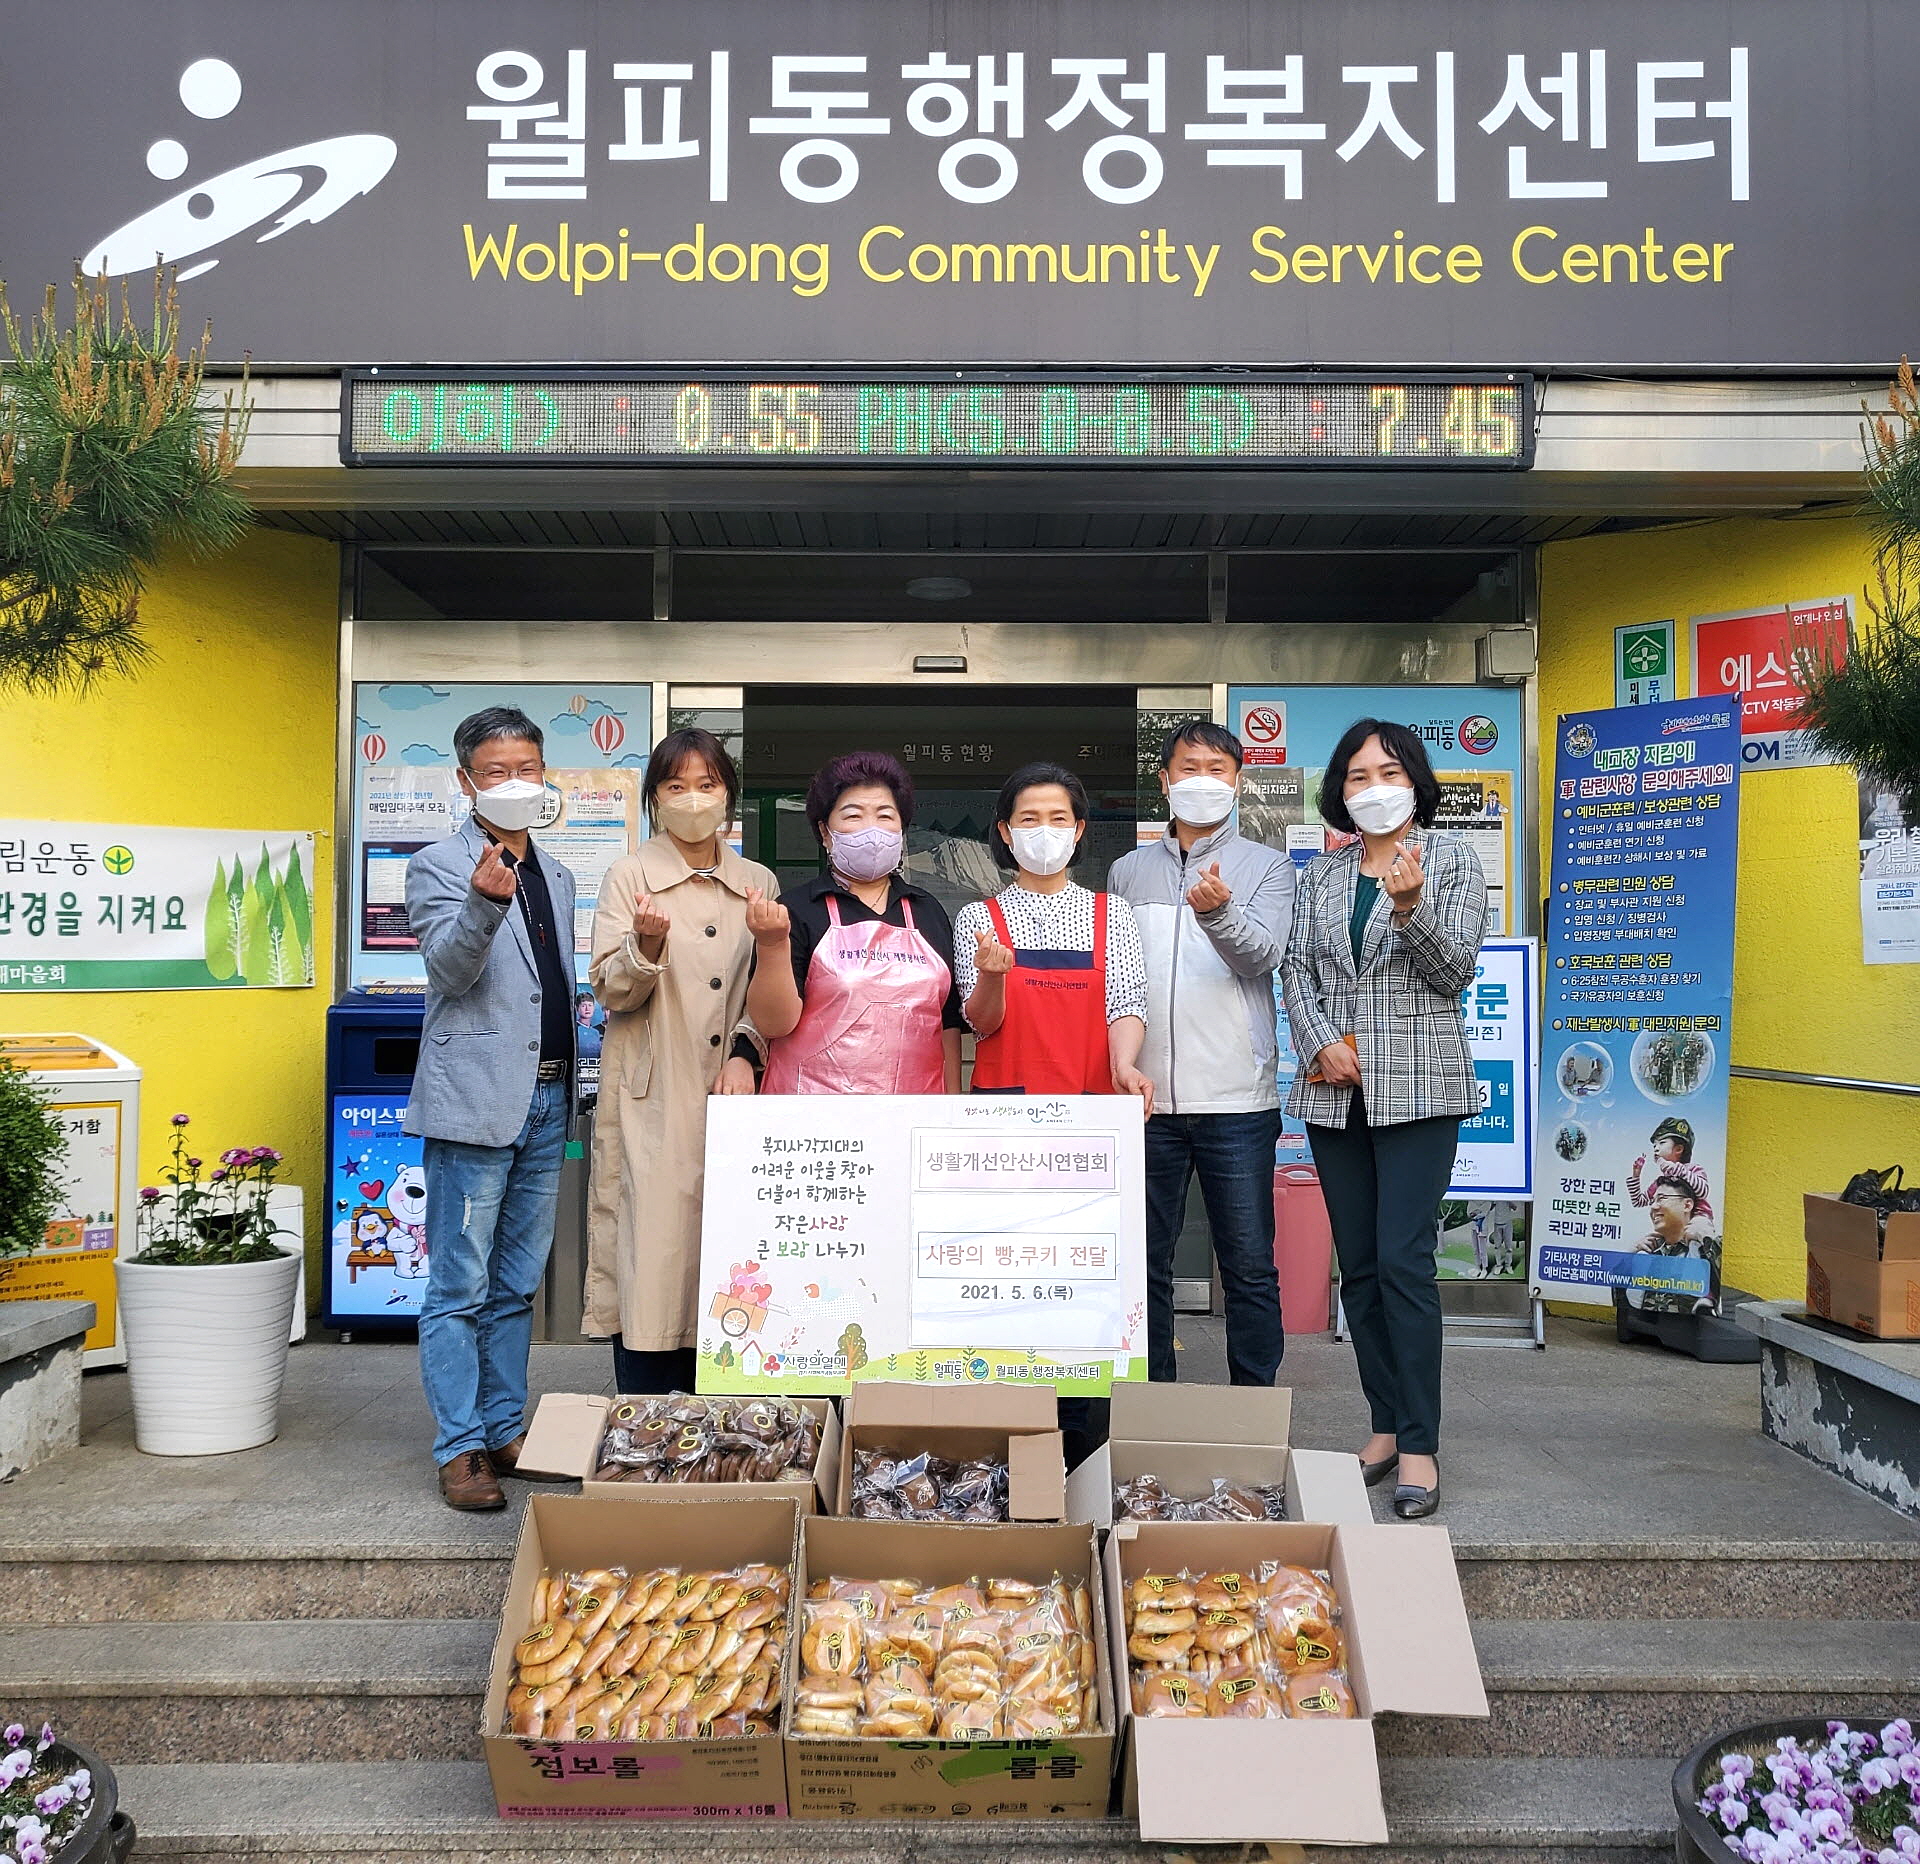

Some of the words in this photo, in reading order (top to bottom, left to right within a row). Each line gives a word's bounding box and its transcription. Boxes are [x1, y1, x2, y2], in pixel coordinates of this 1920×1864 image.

[466, 47, 1749, 206] 월피동행정복지센터
[462, 223, 830, 297] Wolpi-dong
[858, 225, 1222, 297] Community
[1249, 225, 1483, 285] Service
[1511, 225, 1735, 285] Center
[675, 384, 821, 454] 0.55
[1368, 385, 1517, 456] 7.45
[903, 744, 954, 762] 월피동
[960, 744, 995, 762] 현황
[1594, 748, 1639, 771] 내고장
[1644, 742, 1696, 767] 지킴이!
[1243, 784, 1298, 795] 기다리지않고
[1560, 780, 1575, 798] 軍
[1581, 774, 1636, 797] 관련사항
[1642, 765, 1733, 791] 문의해주세요!
[369, 802, 425, 814] 매입임대주택
[427, 802, 446, 814] 모집
[1576, 802, 1635, 818] 예비군훈련
[1644, 796, 1693, 814] 보상관련
[1695, 794, 1721, 809] 상담
[1578, 823, 1605, 835] 인터넷
[1615, 822, 1634, 833] 휴일
[1636, 818, 1682, 831] 예비군훈련
[1685, 816, 1704, 828] 신청
[1577, 838, 1622, 850] 예비군훈련
[1625, 836, 1643, 847] 연기
[1646, 835, 1665, 846] 신청
[1624, 852, 1651, 863] 상해시
[1654, 850, 1673, 861] 보상
[1676, 848, 1686, 860] 및
[1573, 877, 1619, 894] 병무관련
[1622, 876, 1647, 891] 민원
[1649, 875, 1675, 890] 상담
[1574, 898, 1594, 910] 장교
[1597, 897, 1607, 909] 및
[1609, 896, 1639, 909] 부사관
[1642, 895, 1662, 907] 지원
[1665, 894, 1685, 906] 신청
[97, 894, 187, 934] 지켜요
[1574, 913, 1593, 926] 입영
[1596, 913, 1615, 925] 신청
[1627, 911, 1666, 923] 징병검사
[1573, 929, 1611, 942] 입영장병
[1614, 928, 1653, 940] 부대배치
[1656, 927, 1677, 939] 확인
[1568, 954, 1616, 970] 호국보훈
[1619, 954, 1643, 969] 관련
[1646, 953, 1672, 968] 상담
[1611, 973, 1657, 985] 무공수훈자
[1660, 973, 1679, 984] 훈장
[1682, 972, 1701, 984] 찾기
[1570, 990, 1624, 1001] 국가유공자의
[1626, 989, 1664, 1001] 보훈신청
[1566, 1016, 1625, 1031] 재난발생시
[1643, 1016, 1692, 1031] 대민지원
[1694, 1016, 1720, 1030] 문의
[1498, 1082, 1509, 1096] 일
[763, 1136, 864, 1156] 복지사각지대의
[752, 1161, 795, 1180] 어려운
[801, 1160, 836, 1180] 이웃을
[841, 1160, 874, 1180] 찾아
[926, 1152, 1108, 1173] 생활개선안산시연협회
[757, 1184, 800, 1204] 더불어
[806, 1184, 867, 1205] 함께하는
[1560, 1178, 1586, 1194] 강한
[1589, 1179, 1615, 1195] 군대
[1552, 1199, 1591, 1215] 따뜻한
[1595, 1200, 1621, 1217] 육군
[1548, 1220, 1587, 1237] 국민과
[1592, 1222, 1622, 1239] 함께!
[757, 1239, 770, 1260] 큰
[777, 1241, 810, 1258] 보람
[816, 1242, 865, 1259] 나누기
[926, 1244, 983, 1266] 사랑의
[995, 1245, 1057, 1267] 빵,쿠키
[1070, 1245, 1107, 1267] 전달
[1544, 1251, 1580, 1267] 기타사항
[1583, 1254, 1602, 1267] 문의
[961, 1285, 1004, 1300] 2021.
[1011, 1285, 1026, 1300] 5.
[1033, 1285, 1074, 1301] 6.(목)
[784, 1356, 846, 1370] 사랑의열매
[934, 1363, 963, 1380] 월피동
[996, 1365, 1029, 1378] 월피동
[1033, 1365, 1100, 1379] 행정복지센터
[529, 1754, 645, 1780] 점보롤
[692, 1805, 729, 1817] 300m
[735, 1807, 742, 1816] x
